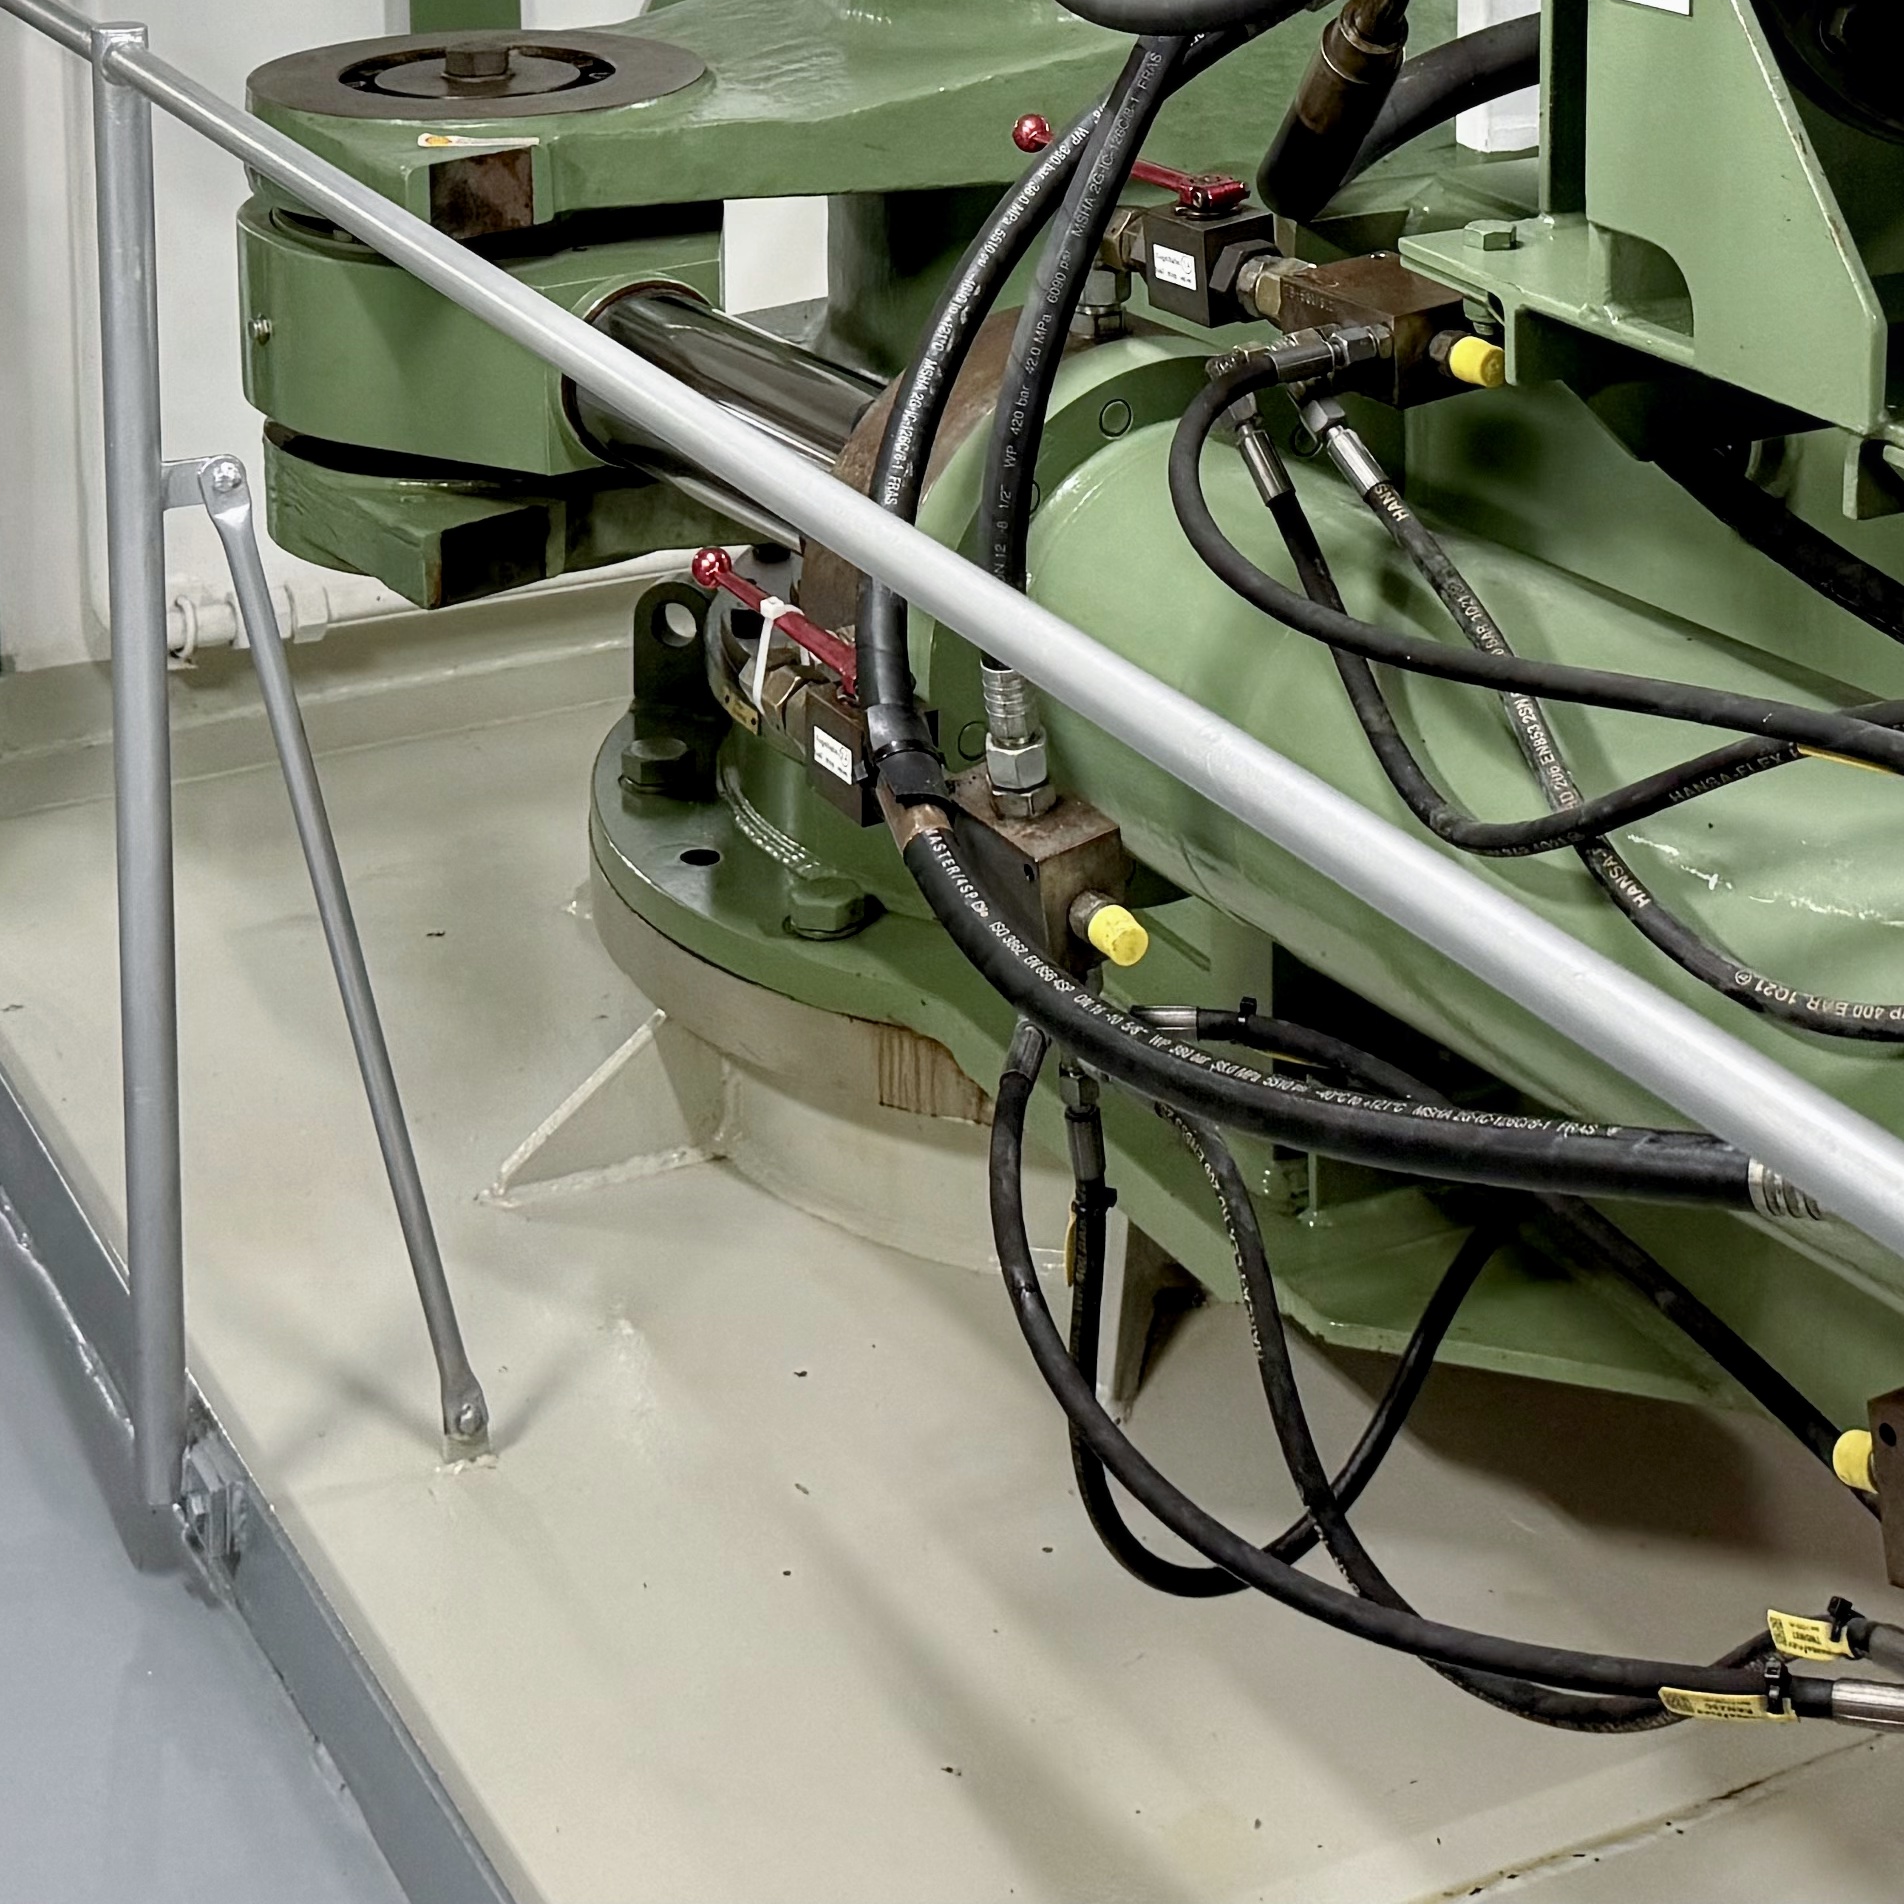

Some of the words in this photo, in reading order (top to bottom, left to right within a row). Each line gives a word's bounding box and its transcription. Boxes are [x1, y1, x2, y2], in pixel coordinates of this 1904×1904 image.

[1138, 52, 1162, 94] FRAS
[1070, 126, 1090, 146] WP
[1071, 194, 1097, 238] MSHA
[984, 228, 1007, 255] 5510
[1046, 272, 1065, 305] 6090
[1038, 313, 1053, 346] MPa
[1025, 346, 1042, 375] 42.0
[911, 358, 938, 394] MSHA
[1015, 384, 1031, 409] bar
[1009, 409, 1025, 437] 420
[1004, 444, 1019, 469] WP
[884, 474, 902, 506] FRAS
[1374, 483, 1410, 522] HANS
[993, 543, 1007, 560] 12
[1475, 624, 1500, 650] BAR
[1514, 698, 1538, 725] 2SN
[1526, 723, 1556, 767] EN853
[1668, 752, 1787, 802] HANSA-FLEX
[1805, 996, 1850, 1018] BAR
[1852, 1005, 1885, 1021] 400
[989, 920, 1011, 938] ISO
[1002, 934, 1029, 957] 3862
[1555, 1121, 1599, 1138] FRAS
